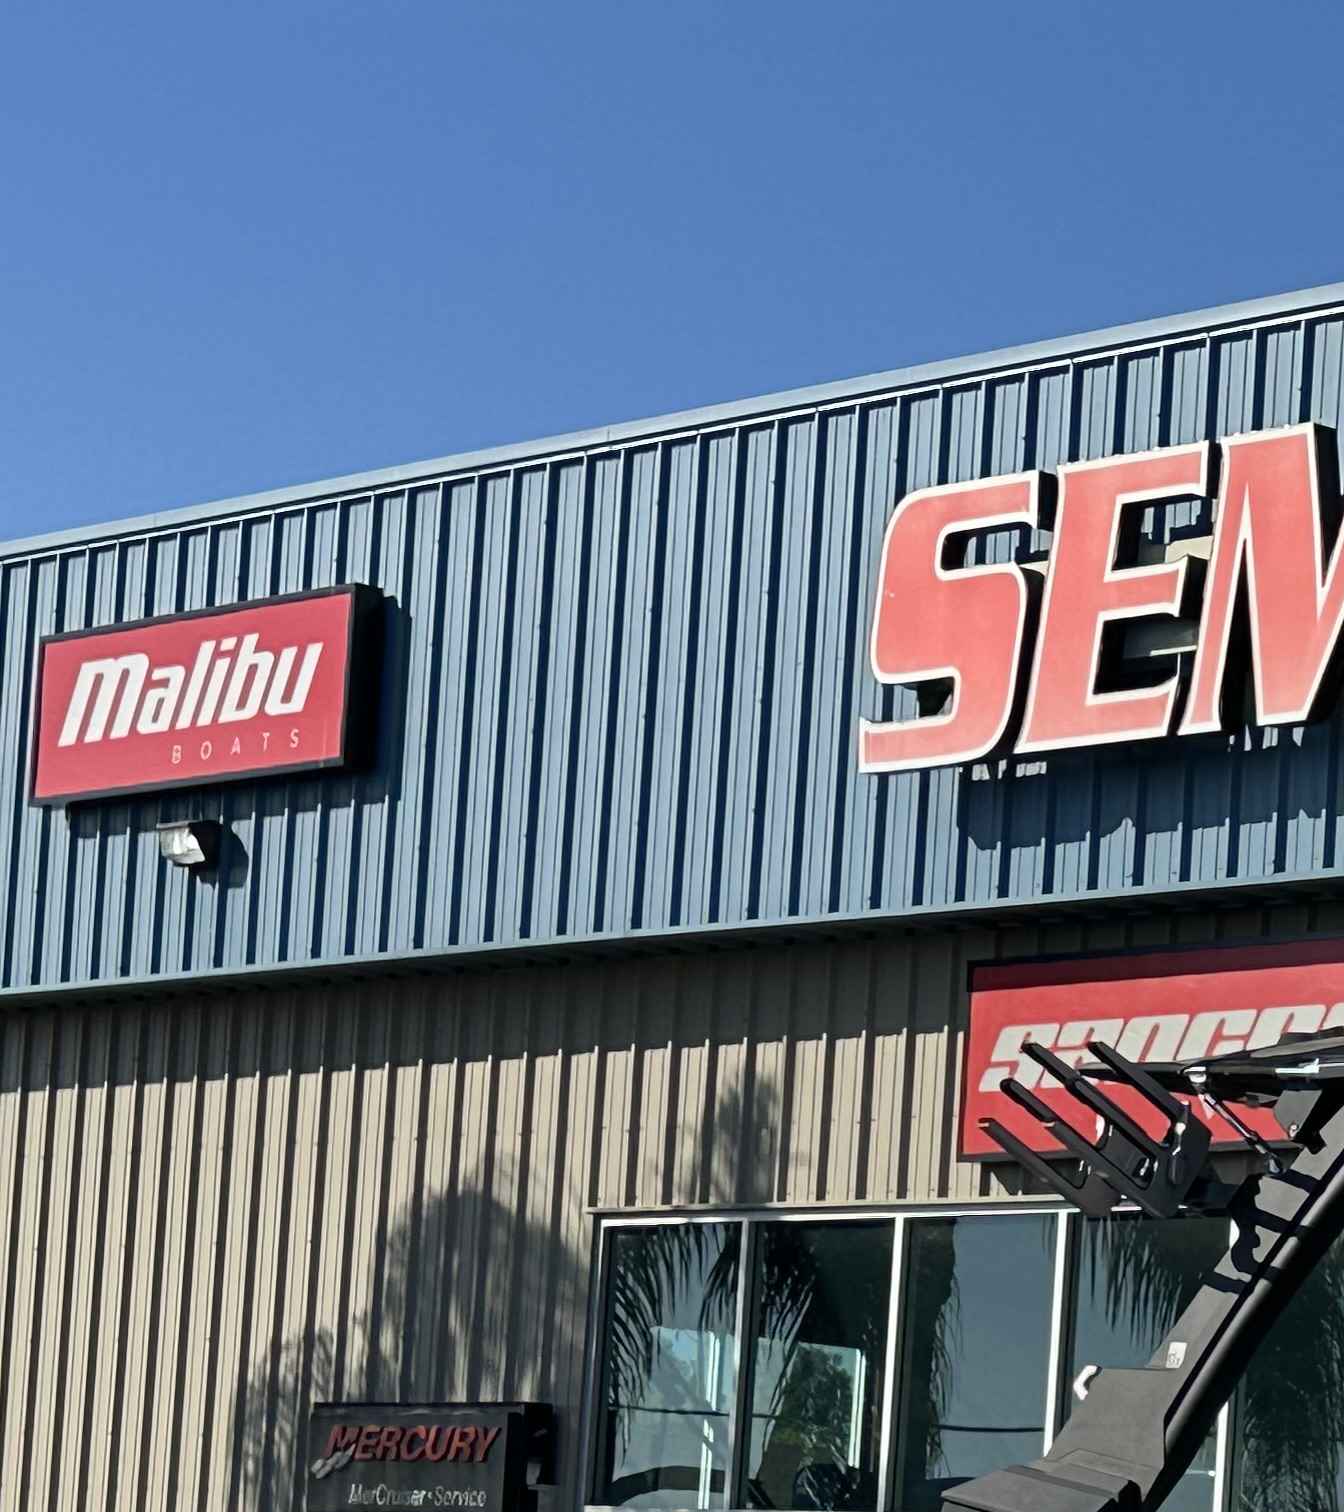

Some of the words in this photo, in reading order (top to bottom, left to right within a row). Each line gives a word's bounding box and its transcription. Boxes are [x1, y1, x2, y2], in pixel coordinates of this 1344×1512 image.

[57, 632, 324, 748] Malibu
[171, 727, 301, 765] BOATS
[324, 1423, 500, 1463] MERCURY
